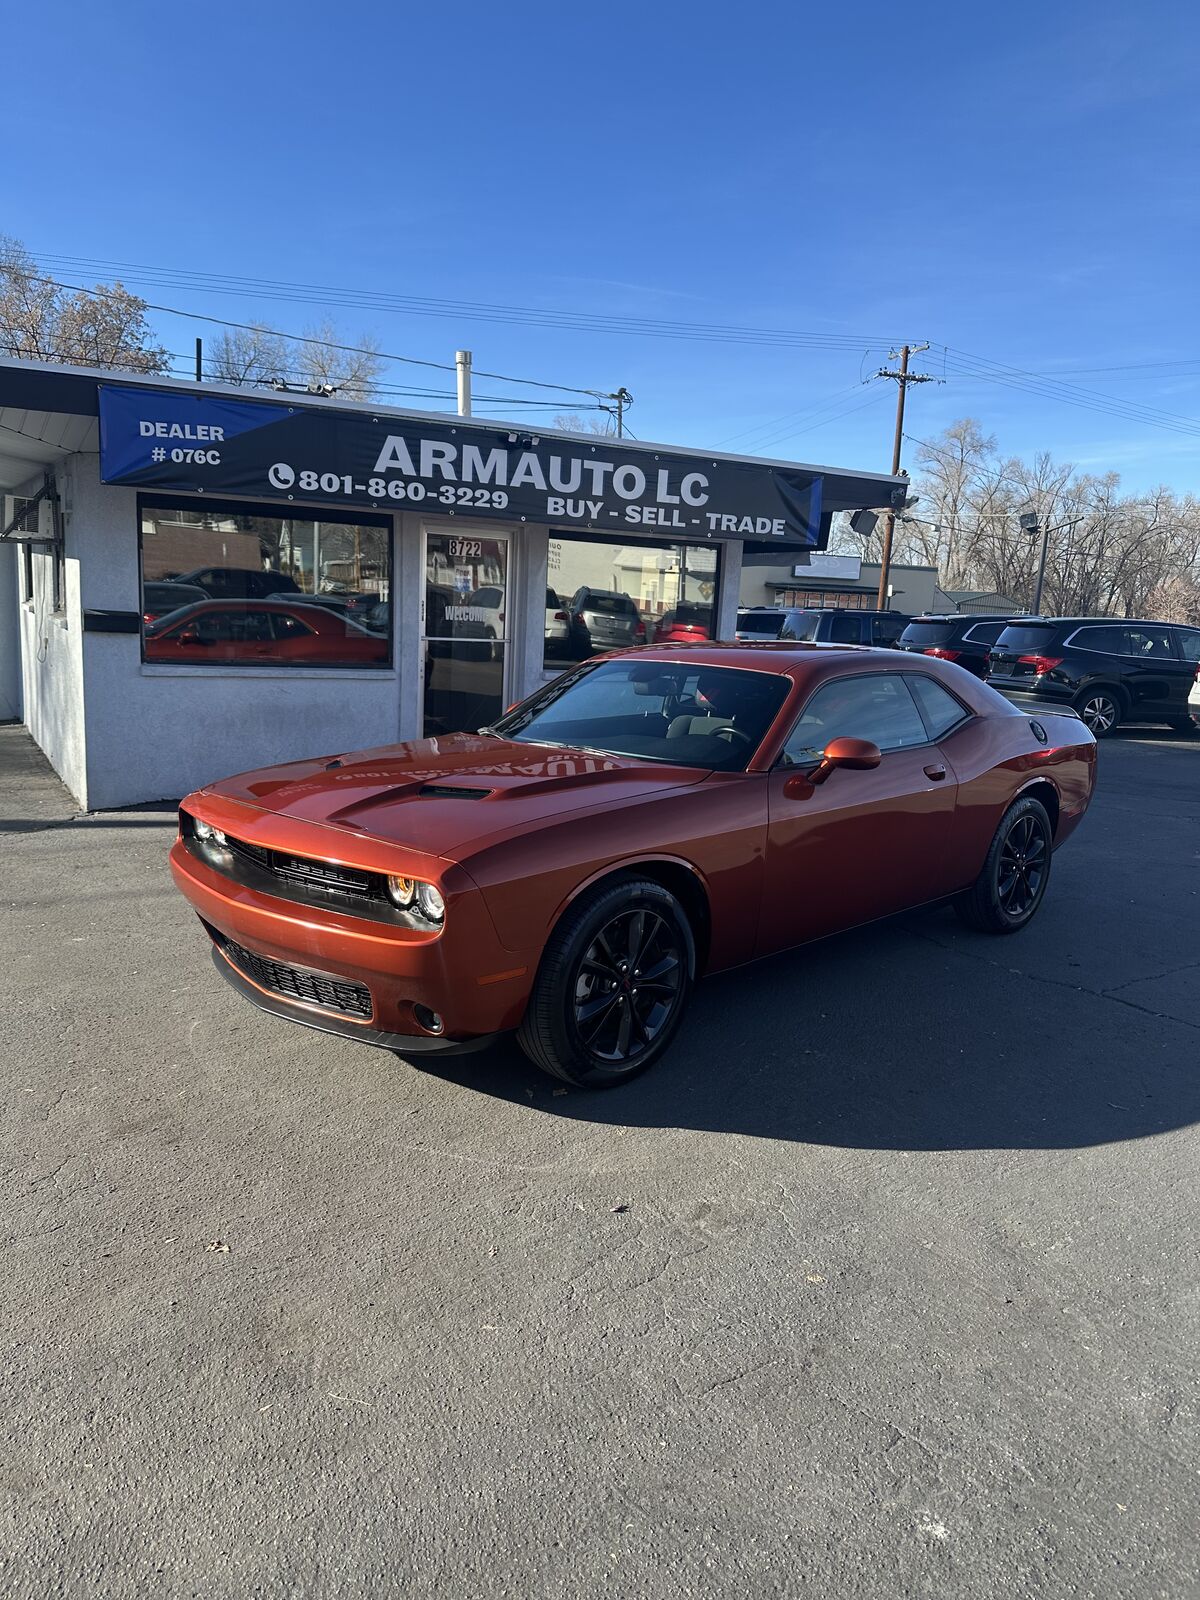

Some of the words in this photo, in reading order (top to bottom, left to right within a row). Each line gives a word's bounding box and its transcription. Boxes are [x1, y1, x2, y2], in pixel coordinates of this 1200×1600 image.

[139, 421, 225, 442] DEALER
[151, 447, 167, 462] #
[170, 448, 222, 465] 076C
[373, 434, 647, 500] ARMAUTO
[656, 469, 710, 507] LC
[298, 470, 509, 509] 801-860-3229
[546, 497, 604, 520] BUY
[624, 505, 686, 528] SELL
[706, 512, 786, 536] TRADE
[450, 541, 480, 557] 8722
